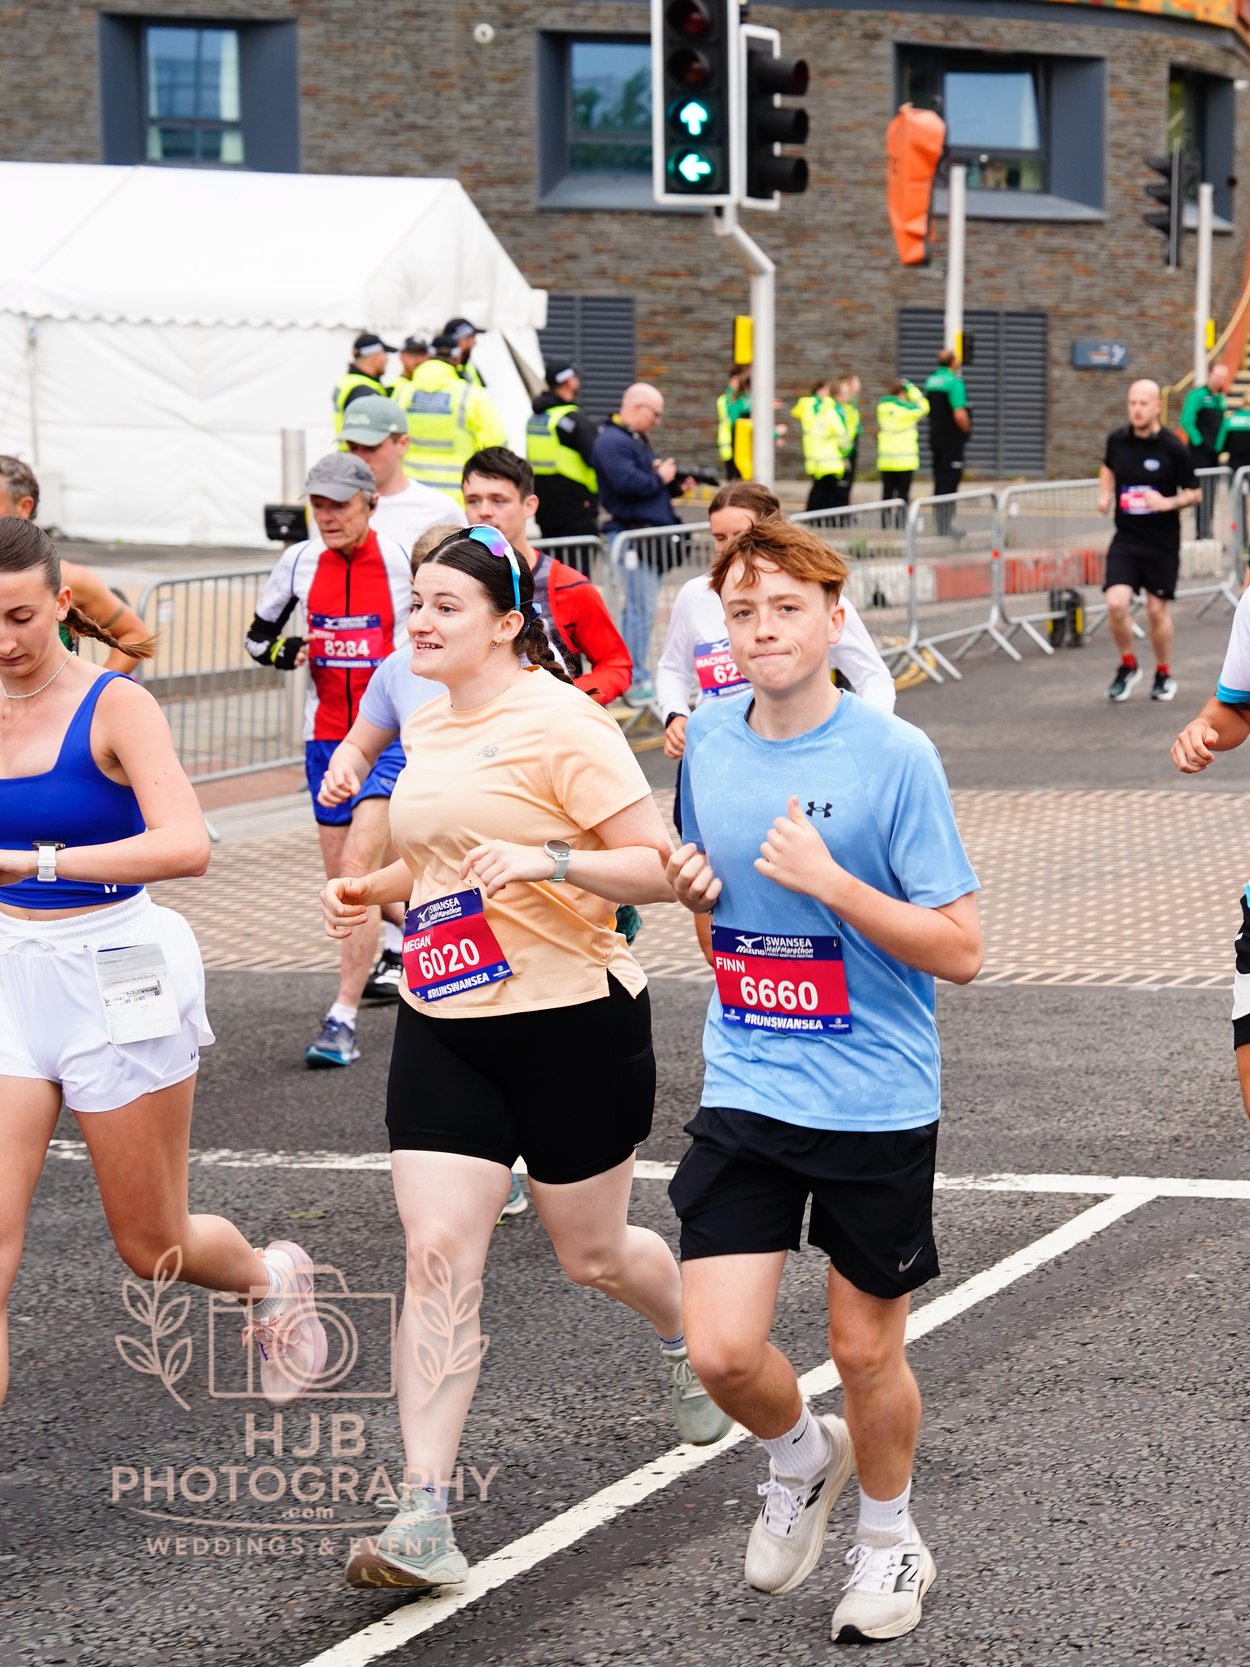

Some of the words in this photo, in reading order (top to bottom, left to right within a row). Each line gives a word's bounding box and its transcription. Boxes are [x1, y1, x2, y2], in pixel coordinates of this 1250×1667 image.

[324, 639, 370, 658] 8284
[713, 662, 742, 684] 62
[429, 897, 461, 914] SWANSEA
[403, 935, 432, 953] MEGAN
[765, 936, 812, 948] SWANSEA
[419, 938, 480, 980] 6020
[716, 956, 745, 973] FINN
[427, 972, 490, 999] #RUNSWANSEA
[740, 976, 818, 1011] 6660
[744, 1012, 823, 1030] #RUNSWANSEA
